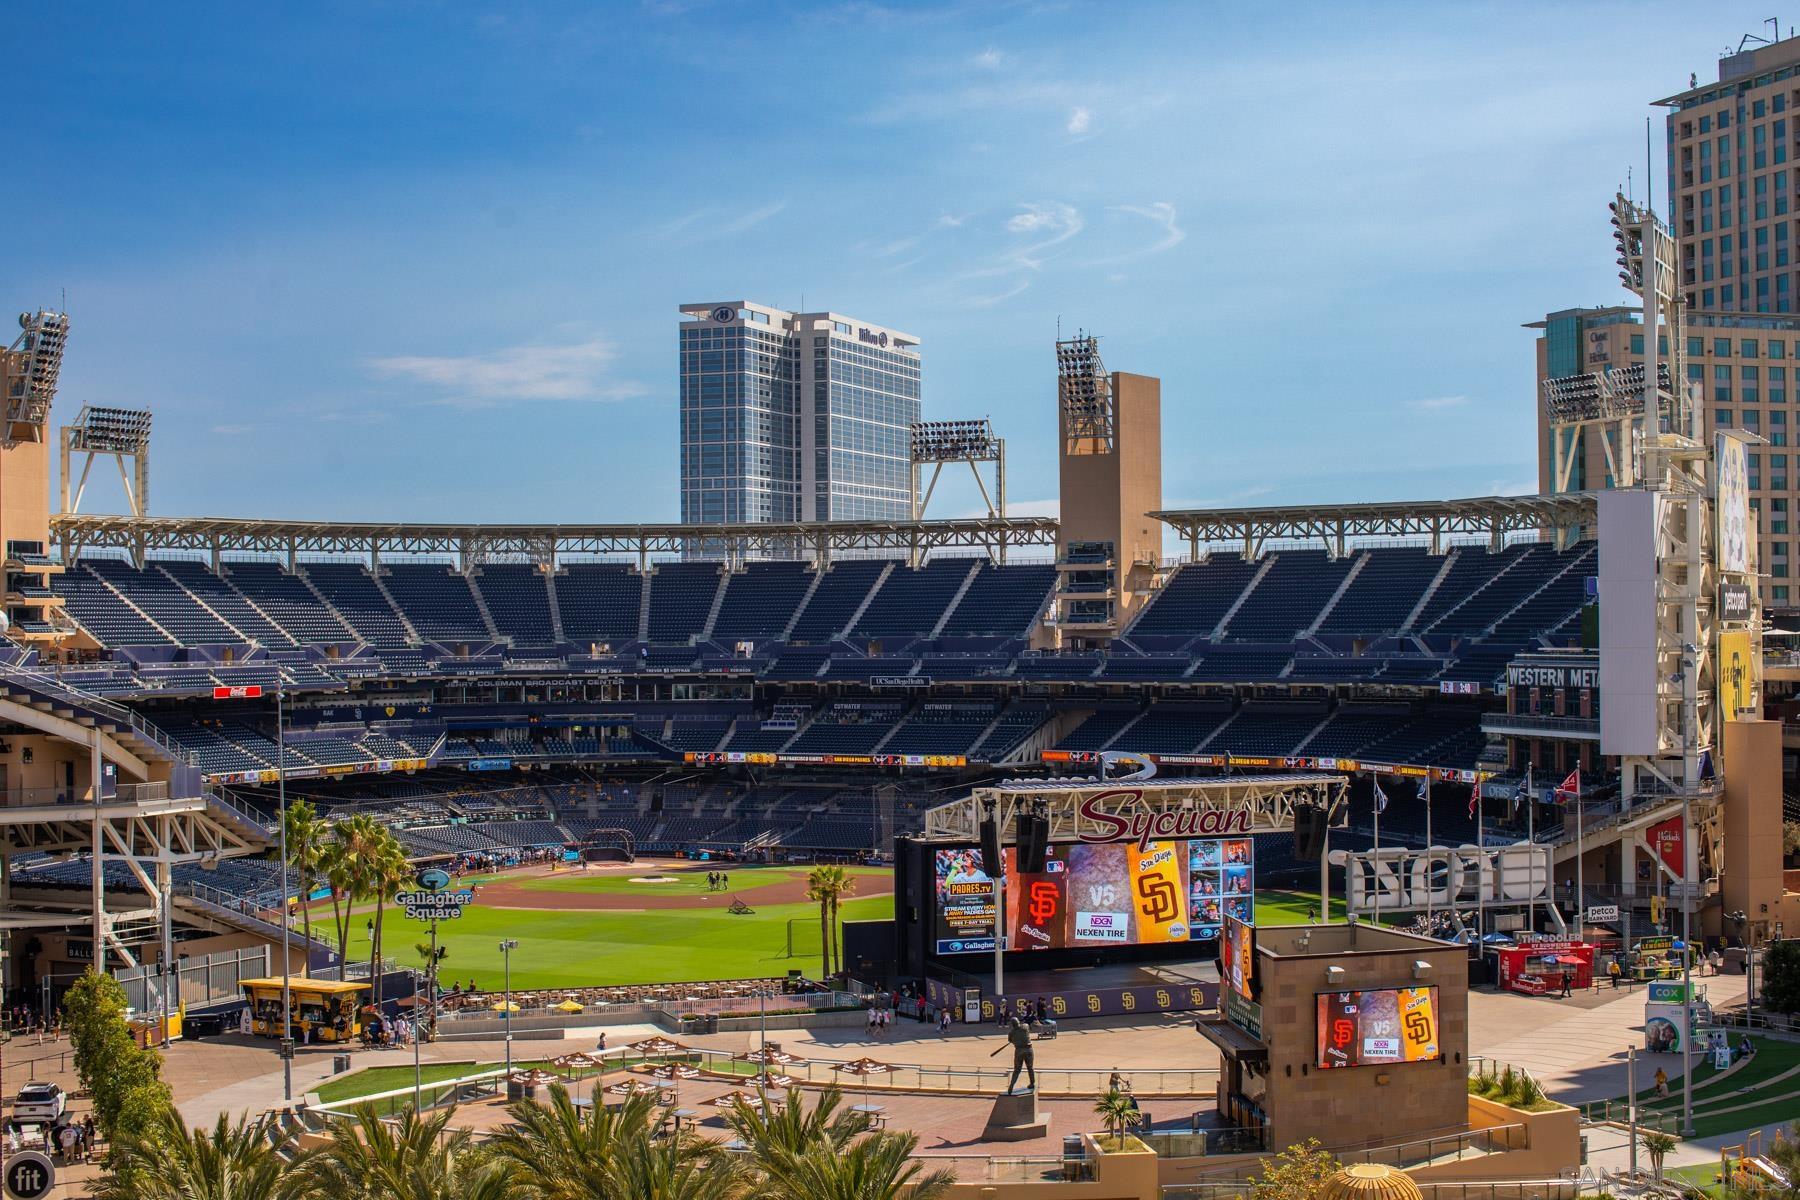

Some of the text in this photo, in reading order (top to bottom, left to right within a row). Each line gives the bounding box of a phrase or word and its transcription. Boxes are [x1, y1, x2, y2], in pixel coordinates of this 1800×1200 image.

[858, 327, 878, 345] Hilton
[1725, 587, 1747, 615] petco park
[1509, 668, 1565, 686] WESTERN
[1489, 786, 1510, 798] ORIS
[1077, 788, 1255, 852] Sycuan
[1140, 848, 1172, 872] San Diego
[951, 883, 991, 895] PADRES.TV
[1089, 884, 1115, 907] VS
[394, 891, 473, 908] Gallagher
[405, 905, 461, 922] Square
[1591, 906, 1615, 917] petco
[1077, 929, 1125, 937] NEXEN TIRE
[1522, 934, 1583, 944] THE COOLER
[964, 941, 995, 951] Gallagher
[1642, 942, 1672, 950] LEMONADE
[1656, 988, 1678, 997] COX
[1373, 1020, 1390, 1035] VS
[16, 1166, 41, 1191] fit
